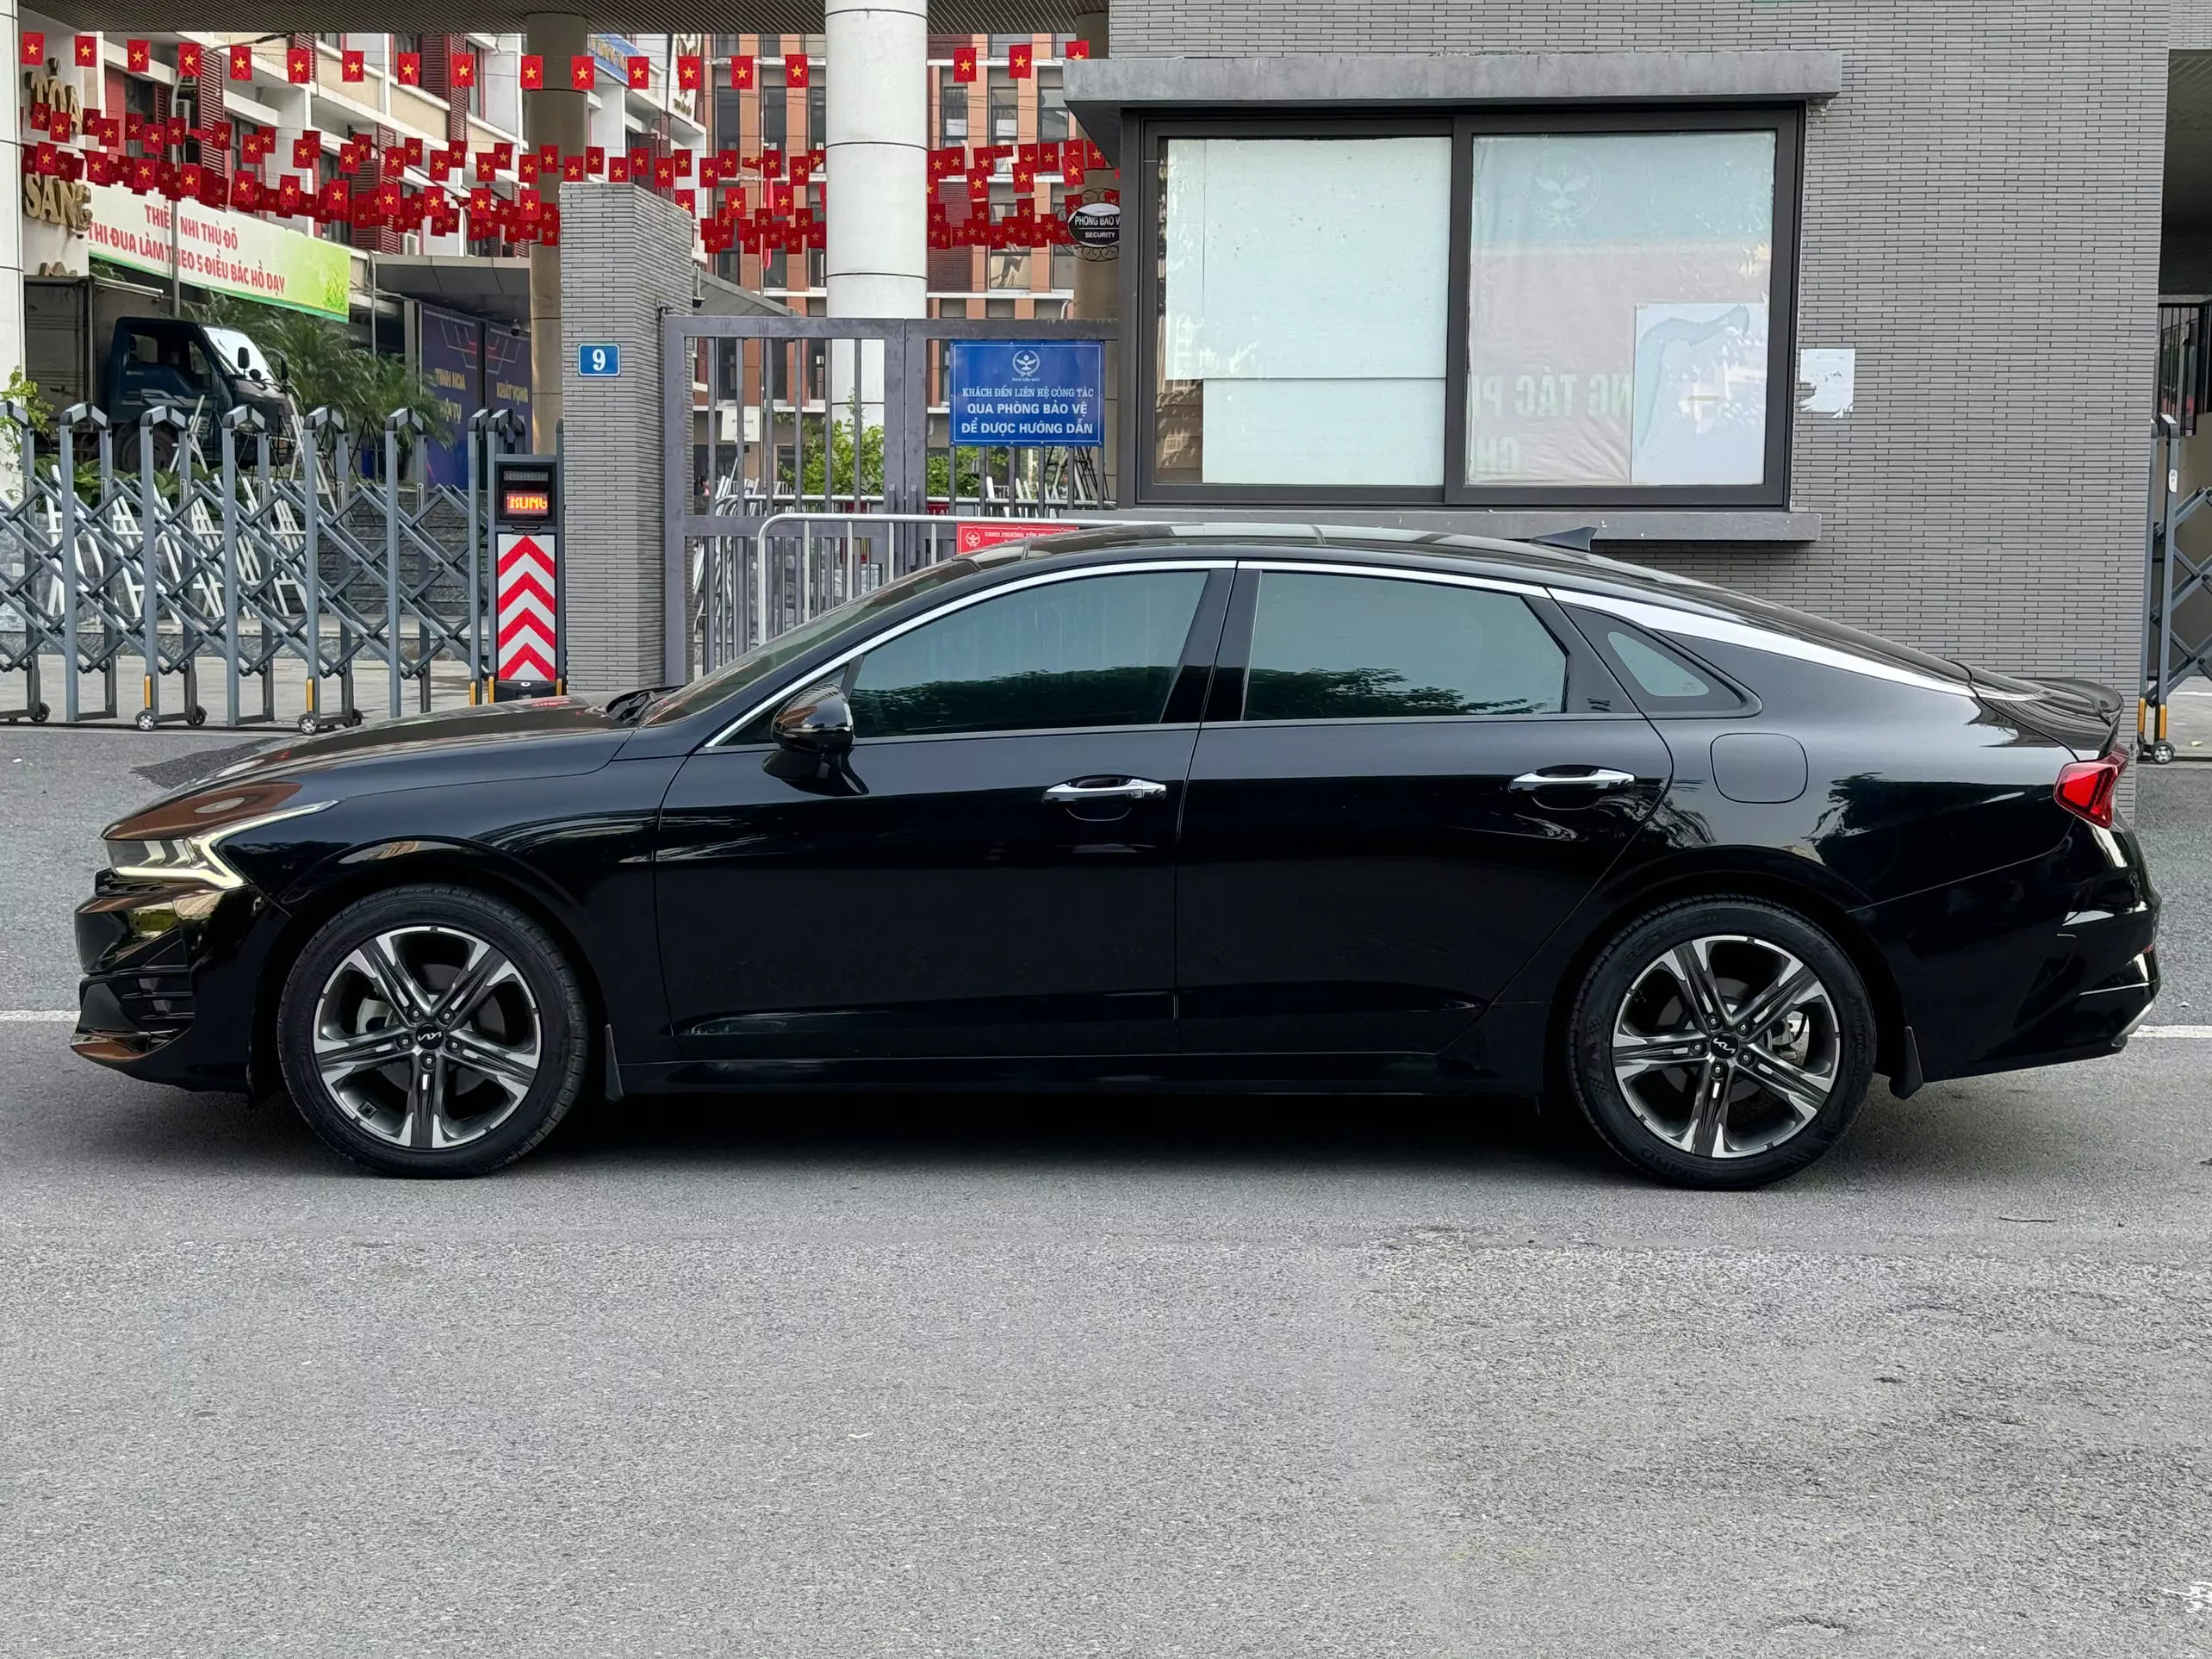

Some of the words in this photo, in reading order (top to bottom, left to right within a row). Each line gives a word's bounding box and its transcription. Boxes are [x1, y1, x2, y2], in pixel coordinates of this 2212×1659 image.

[145, 204, 173, 231] THIÊ
[180, 215, 200, 239] NHI
[201, 220, 222, 246] THỦ
[223, 227, 238, 251] ĐÔ
[89, 221, 109, 245] THI
[109, 227, 137, 253] ĐUA
[139, 232, 165, 263] LÀM
[197, 253, 203, 273] 5
[204, 248, 228, 280] ĐIỀU
[230, 259, 250, 285] BÁC
[251, 259, 265, 289] HỒ
[266, 272, 285, 297] DẠY
[592, 348, 606, 371] 9
[962, 385, 992, 397] KHÁCH
[1015, 385, 1035, 397] LIÊN
[1037, 385, 1050, 400] HỆ
[1051, 385, 1075, 398] CÔNG
[1077, 385, 1094, 397] TÁC
[967, 403, 994, 414] QUA
[997, 401, 1040, 414] PHÒNG
[1043, 399, 1069, 414] BẢO
[1072, 401, 1088, 418] VỆ
[961, 417, 978, 433] ĐỂ
[980, 421, 1016, 437] ĐƯỢC
[1019, 419, 1063, 433] HƯỚNG
[1066, 418, 1093, 433] DẪN
